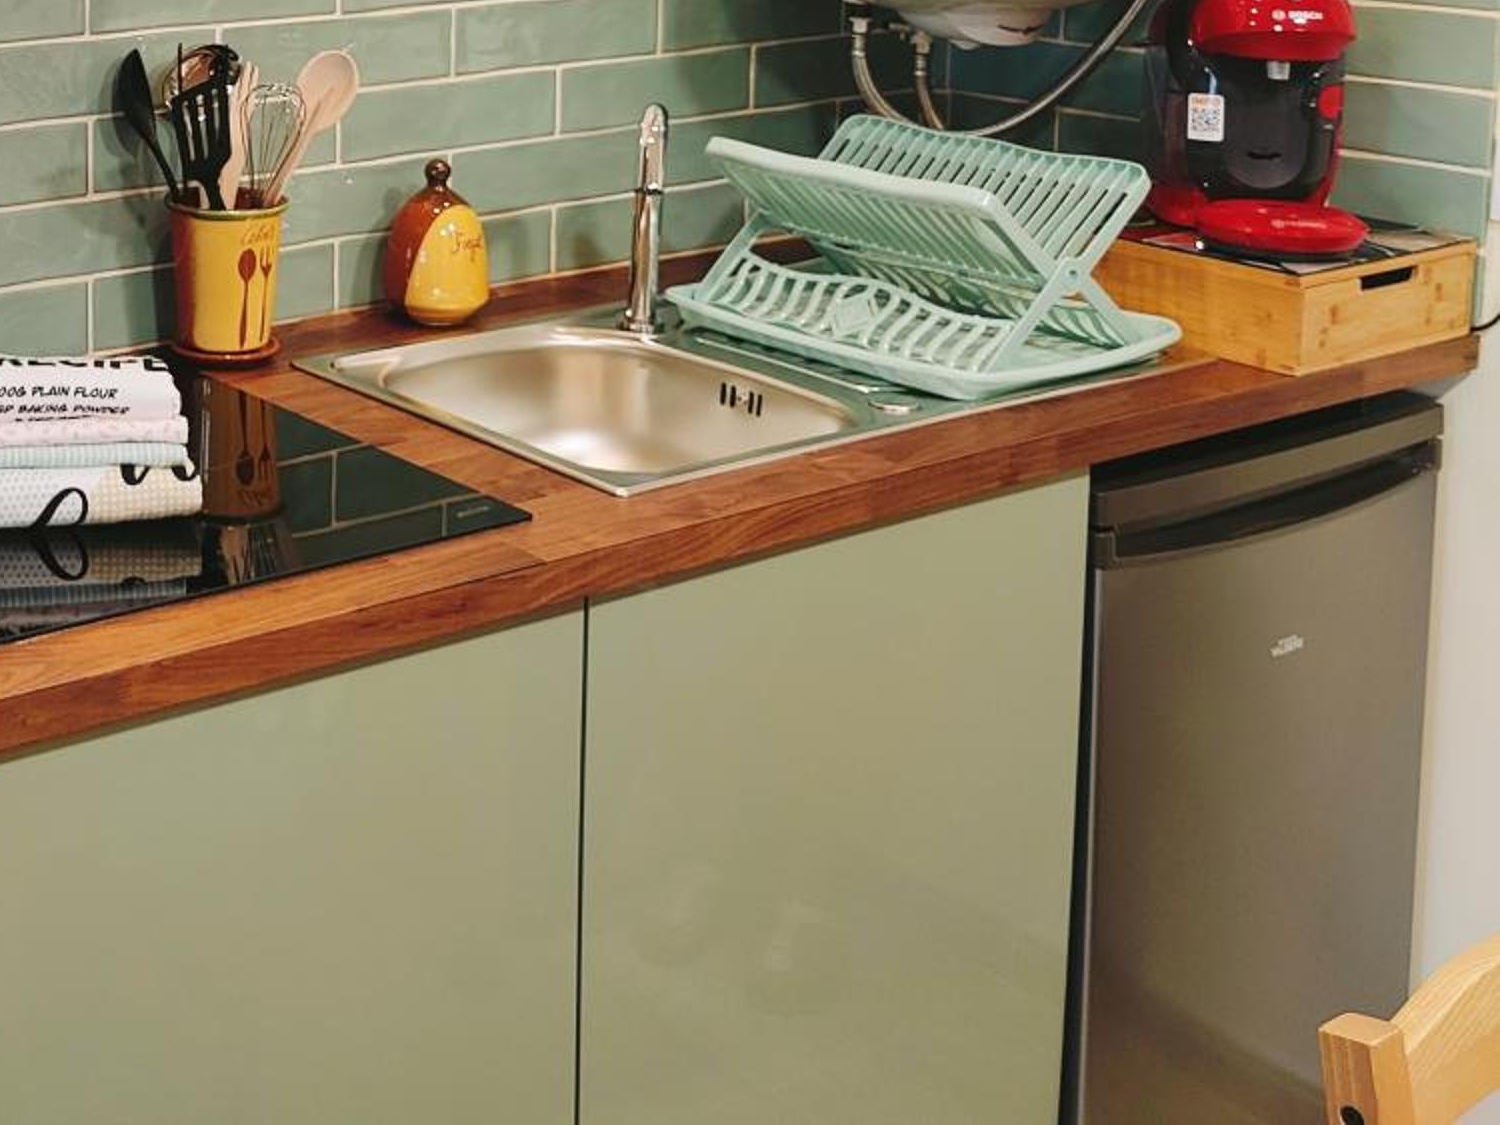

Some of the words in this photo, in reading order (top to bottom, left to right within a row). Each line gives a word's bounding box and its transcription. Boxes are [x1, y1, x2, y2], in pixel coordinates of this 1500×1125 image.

[31, 386, 70, 397] PLAIN
[73, 386, 118, 399] FLOUR
[18, 404, 68, 414] BAKING
